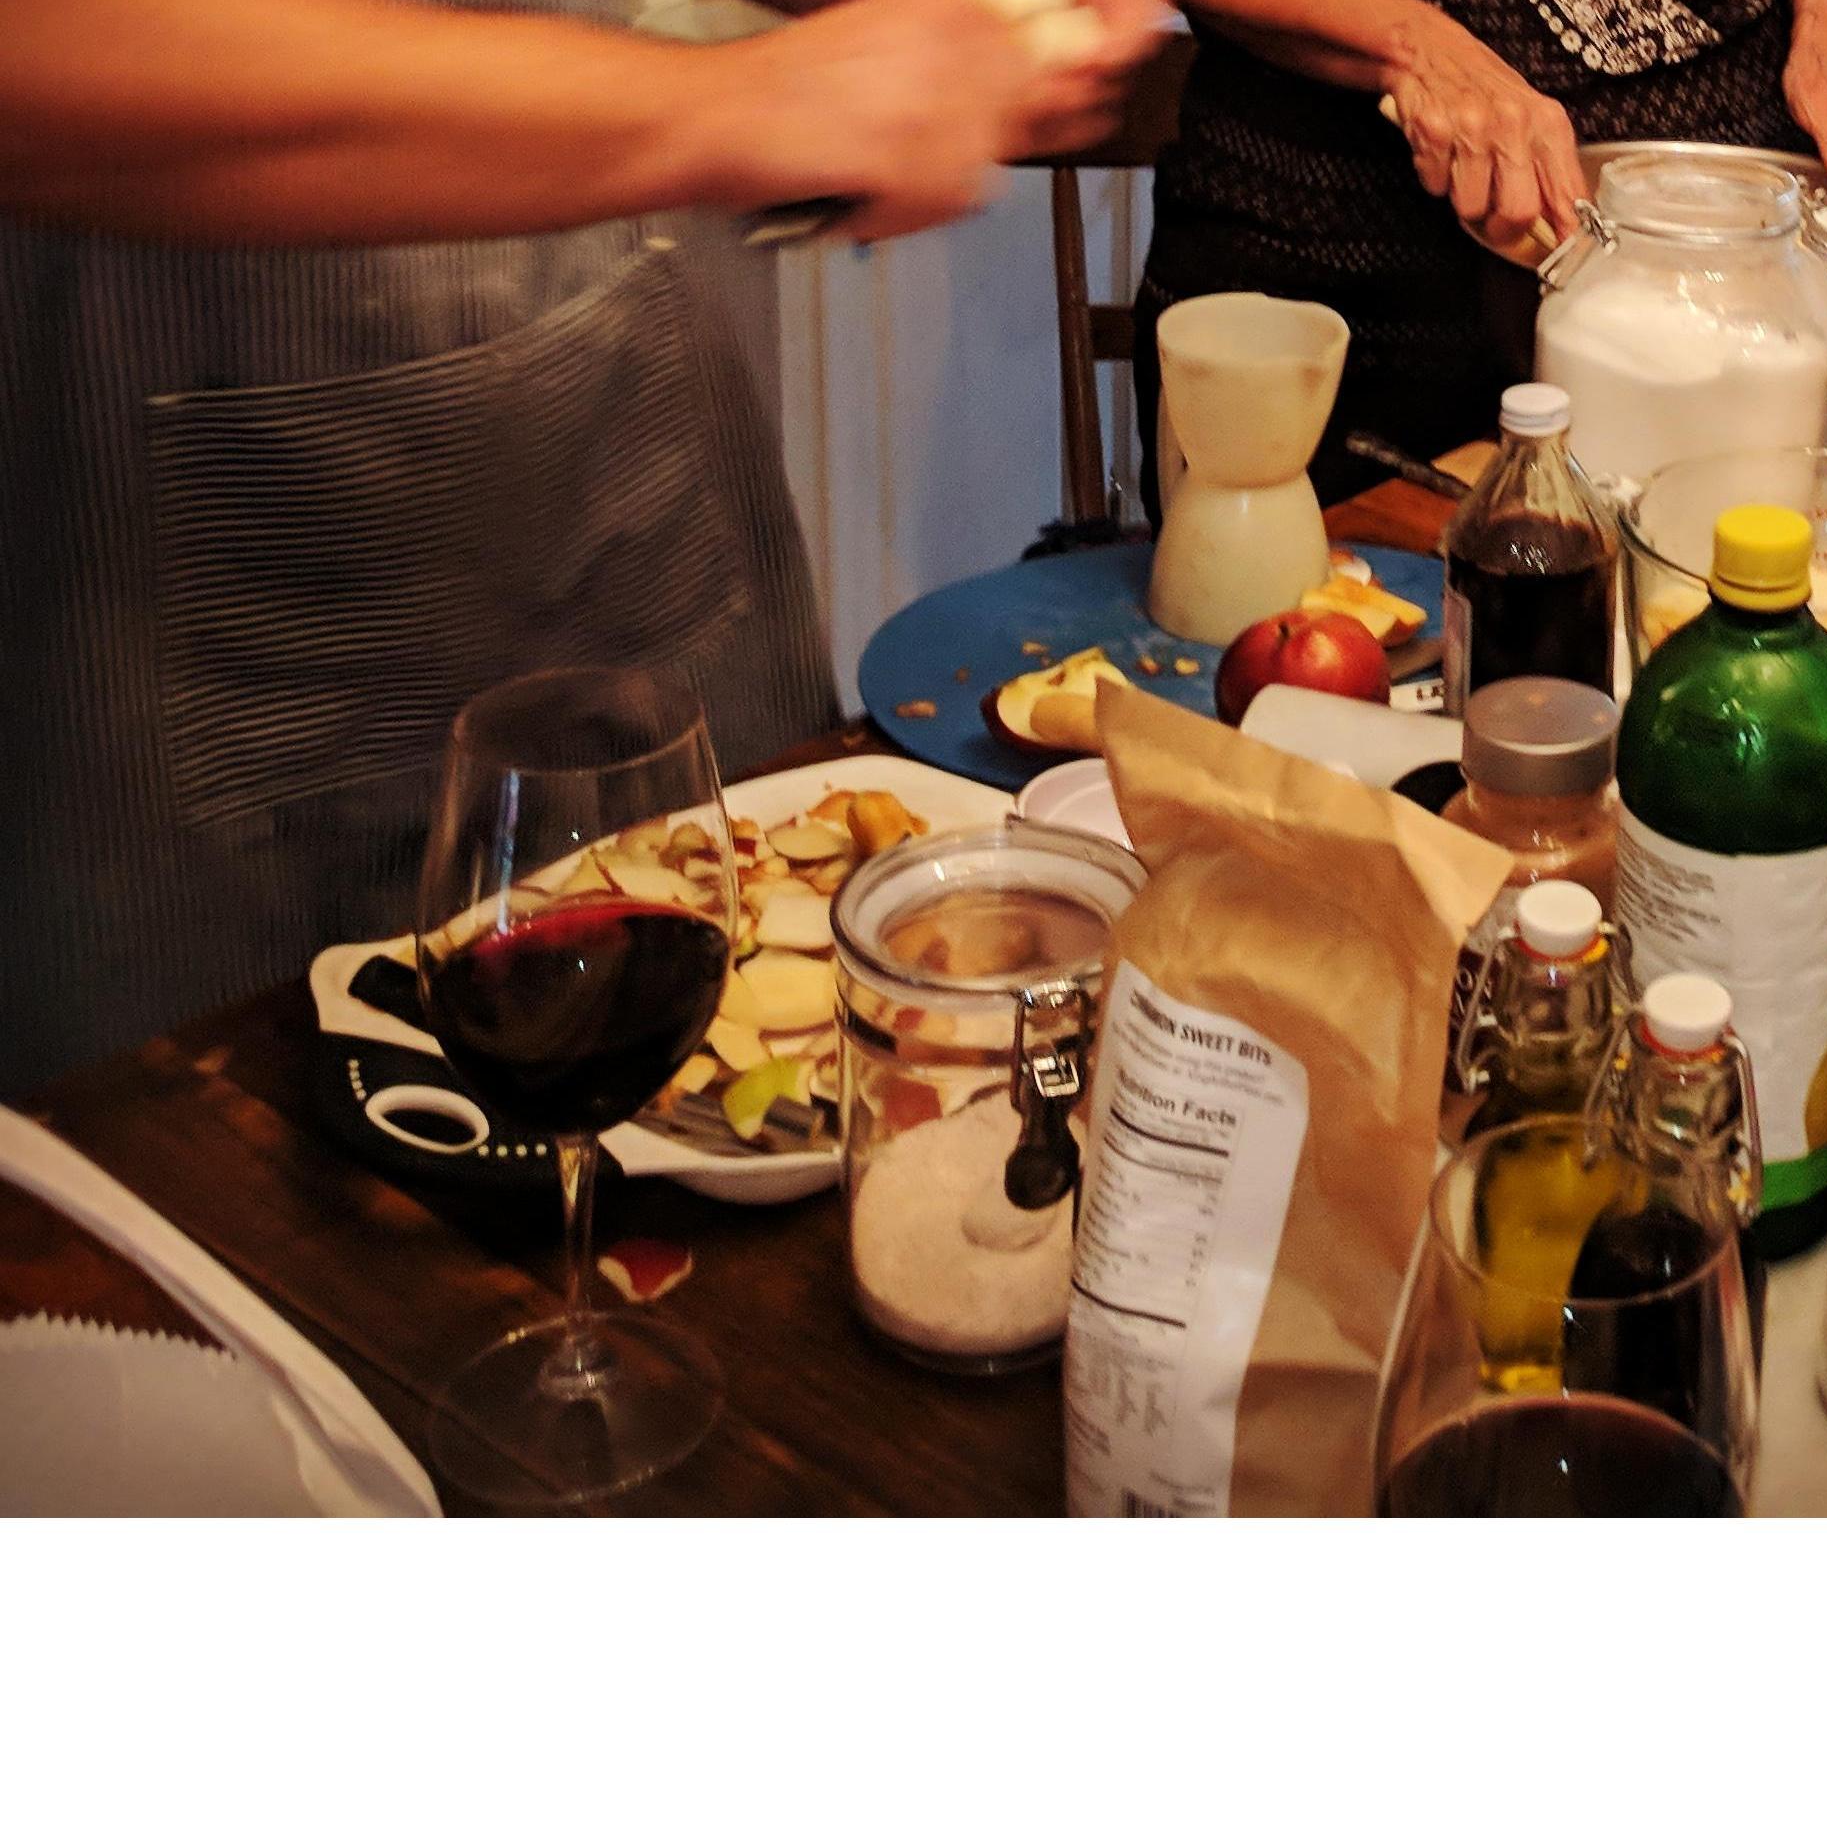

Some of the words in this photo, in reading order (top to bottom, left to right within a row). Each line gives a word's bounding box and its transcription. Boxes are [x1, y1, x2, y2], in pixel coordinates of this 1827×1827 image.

[1181, 1024, 1234, 1054] SWEET
[1238, 1039, 1272, 1066] BITS
[1182, 1100, 1237, 1126] Facts
